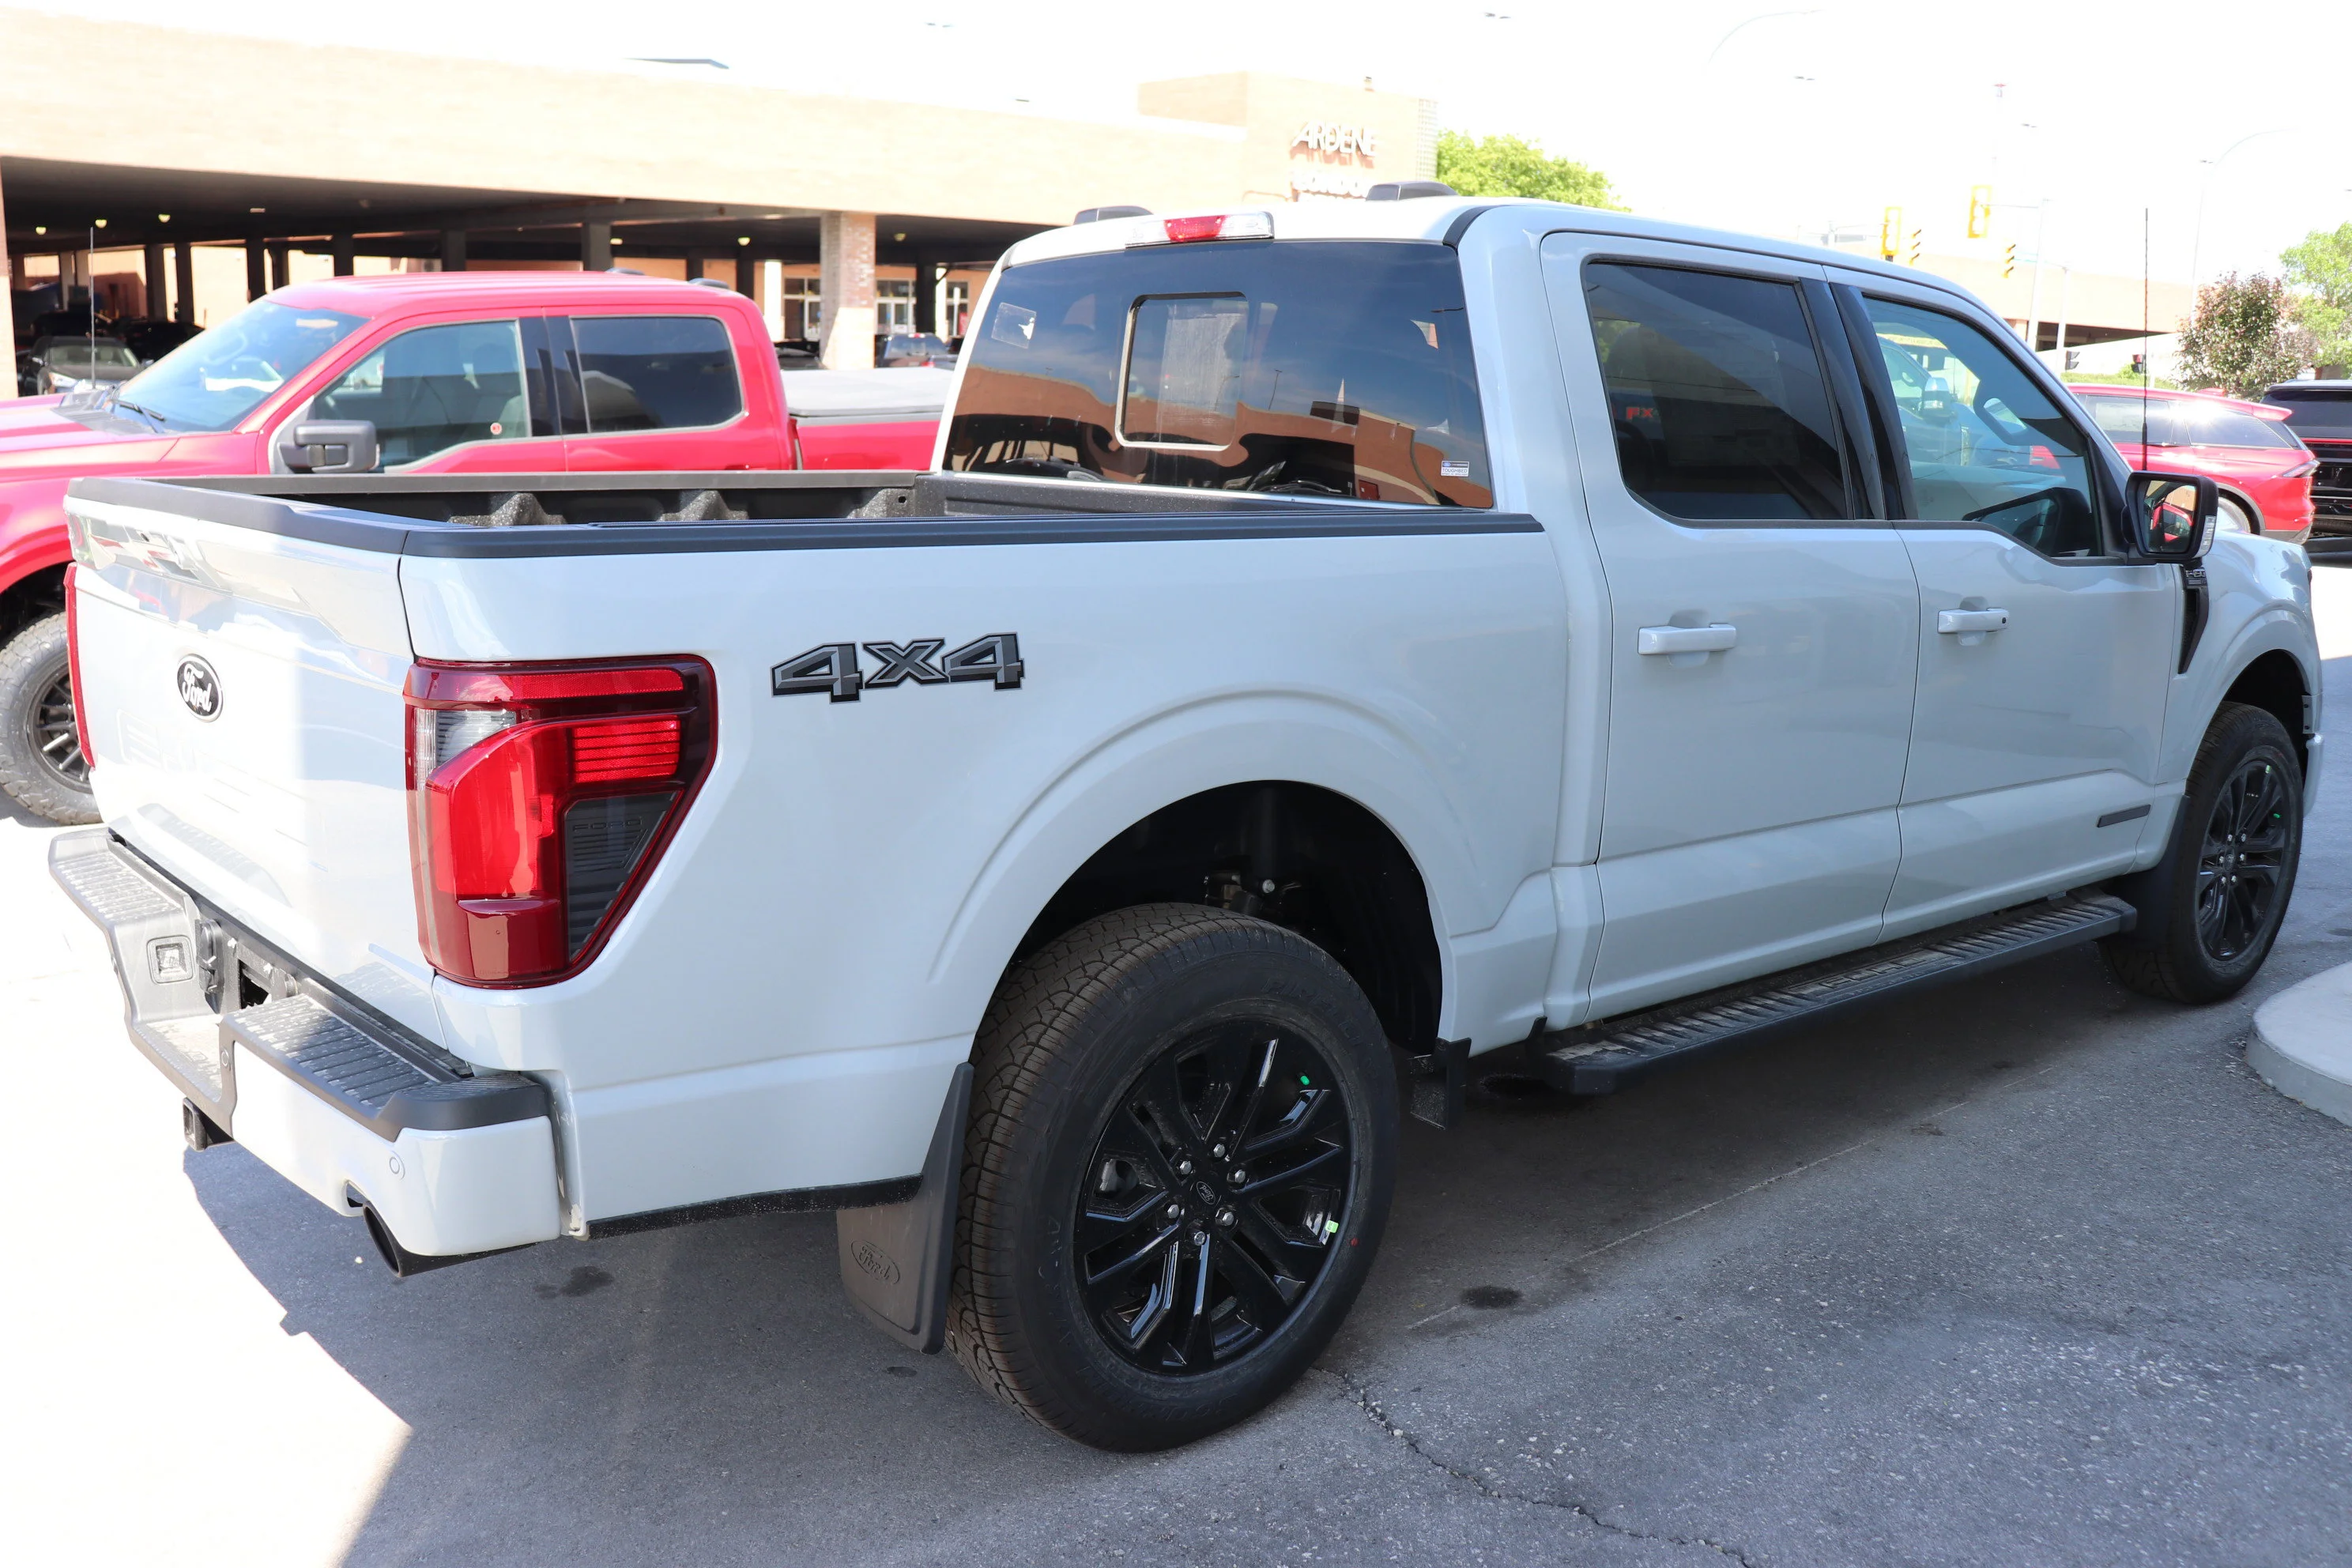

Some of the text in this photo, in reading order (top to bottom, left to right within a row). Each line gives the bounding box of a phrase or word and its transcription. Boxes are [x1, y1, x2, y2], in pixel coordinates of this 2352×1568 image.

[1291, 120, 1380, 157] ARDENE
[182, 663, 213, 712] Ford
[858, 1245, 891, 1280] Ford
